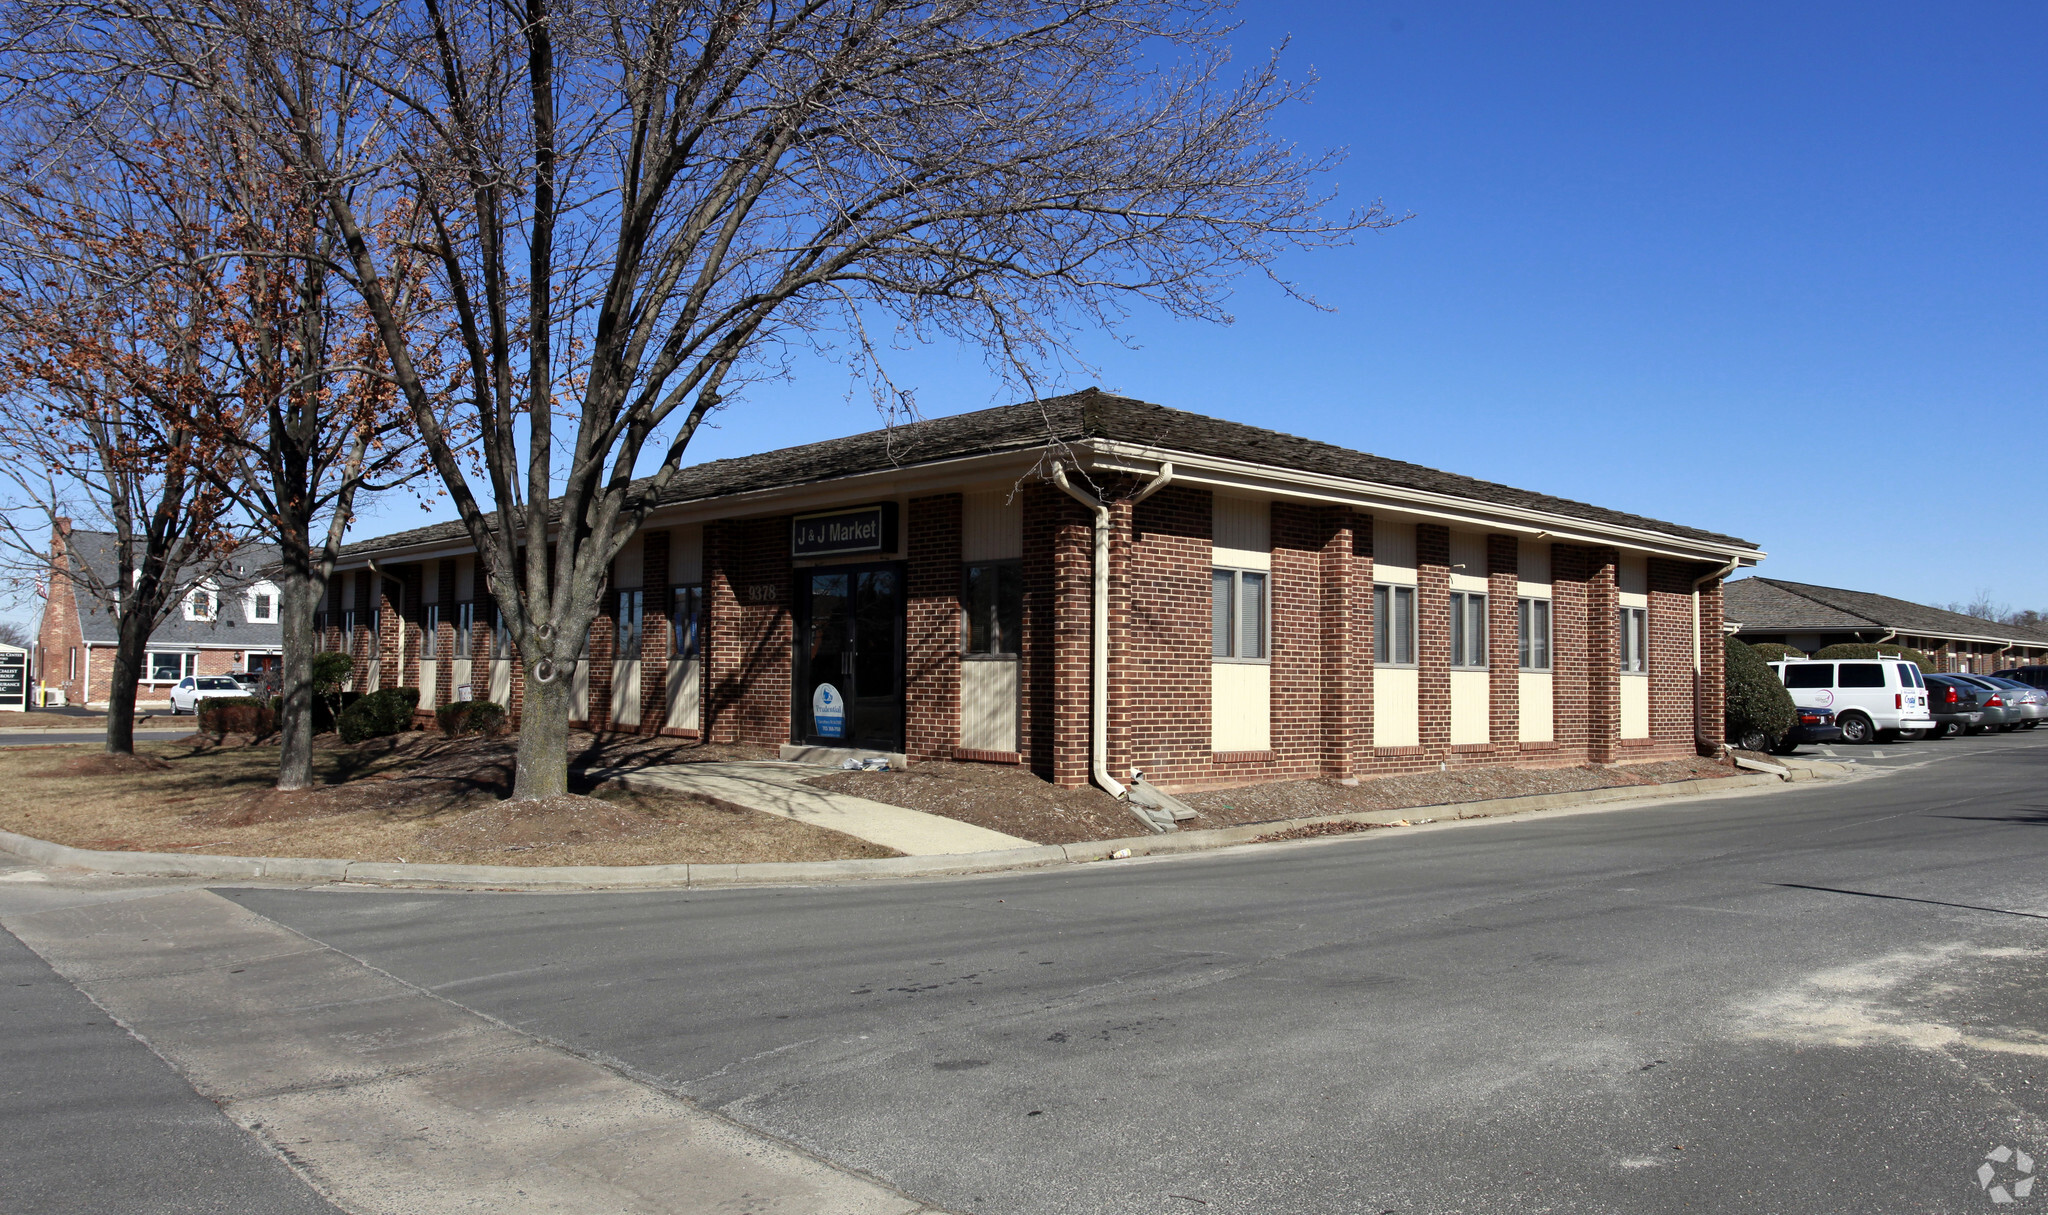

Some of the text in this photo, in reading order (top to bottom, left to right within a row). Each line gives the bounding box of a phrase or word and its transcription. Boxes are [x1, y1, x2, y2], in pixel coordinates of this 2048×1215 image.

[798, 520, 876, 545] J & J Market
[748, 584, 776, 601] 9378
[816, 705, 842, 713] Prudential
